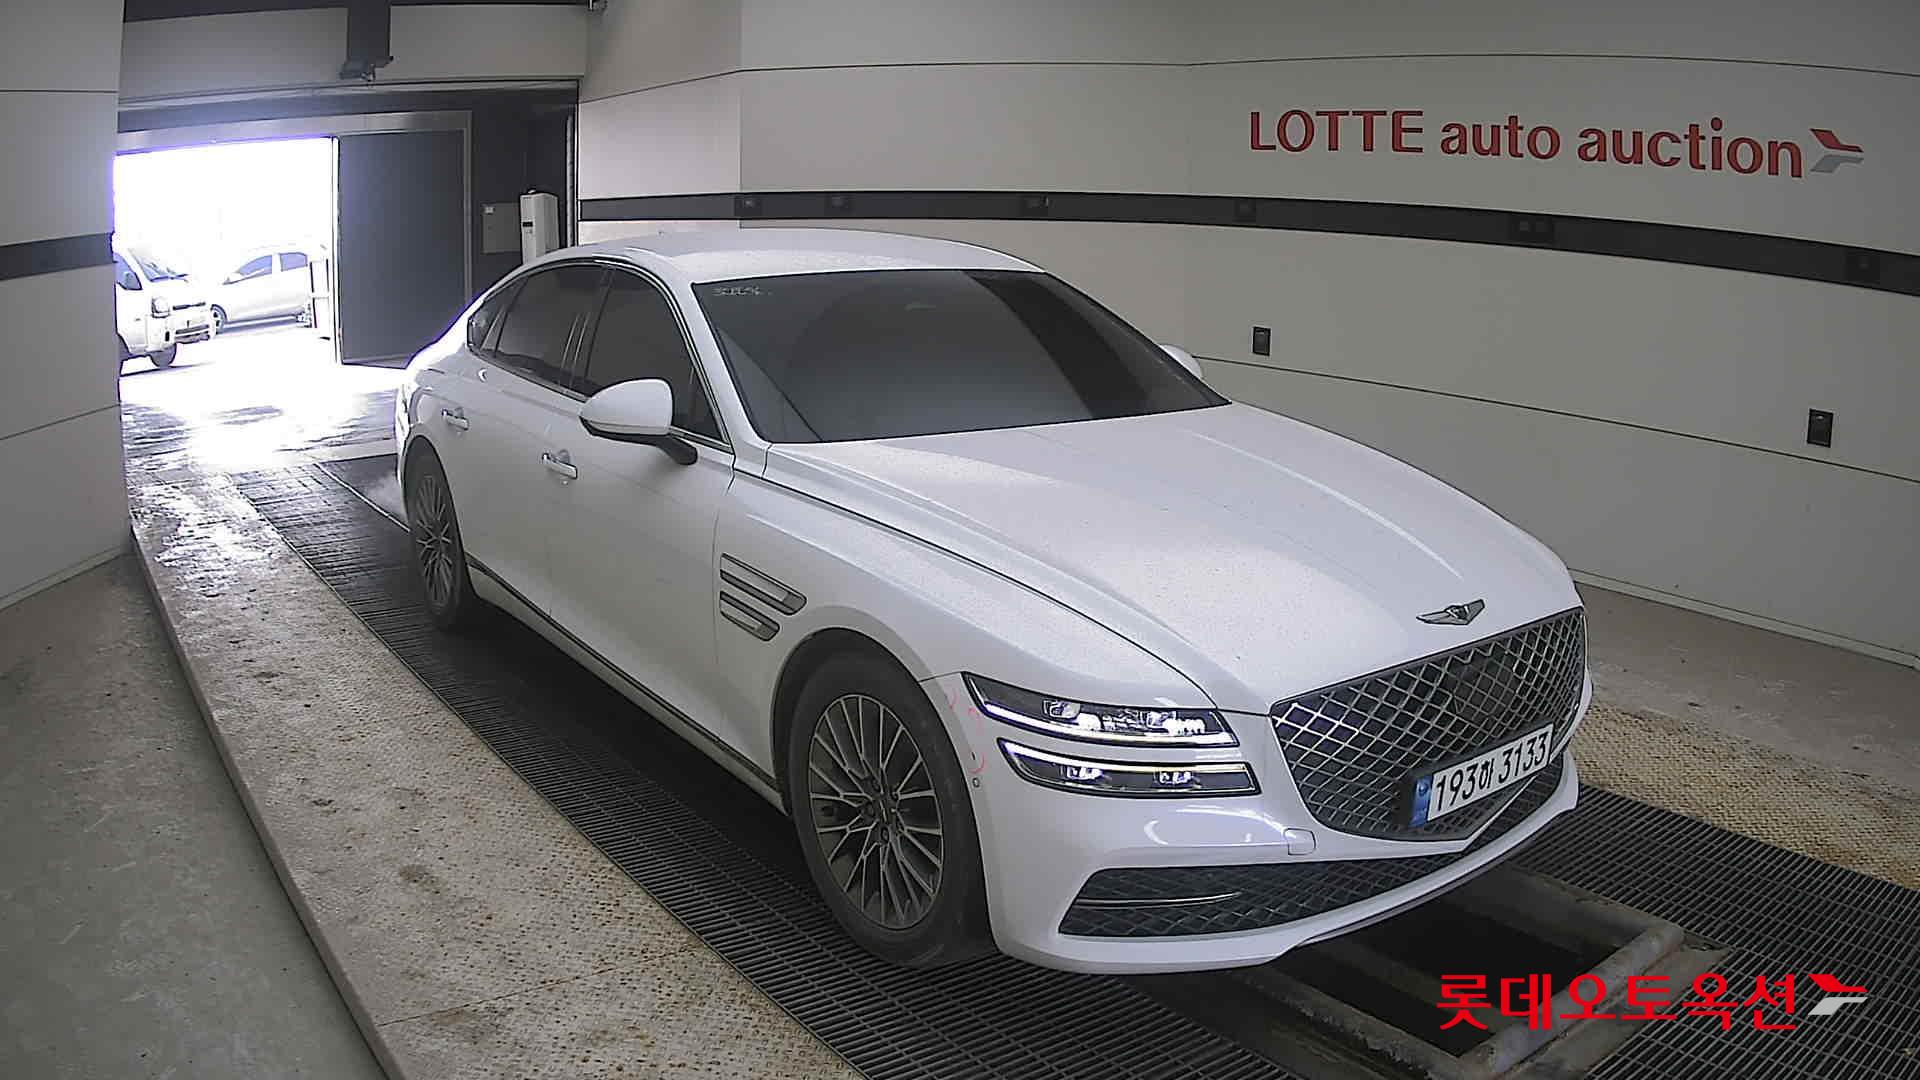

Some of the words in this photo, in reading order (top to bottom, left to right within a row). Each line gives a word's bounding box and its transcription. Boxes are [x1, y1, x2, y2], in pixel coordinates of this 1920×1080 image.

[1250, 111, 1423, 152] LOTTE
[1440, 115, 1560, 160] auto
[1577, 117, 1803, 178] auction
[1499, 732, 1549, 784] 3133
